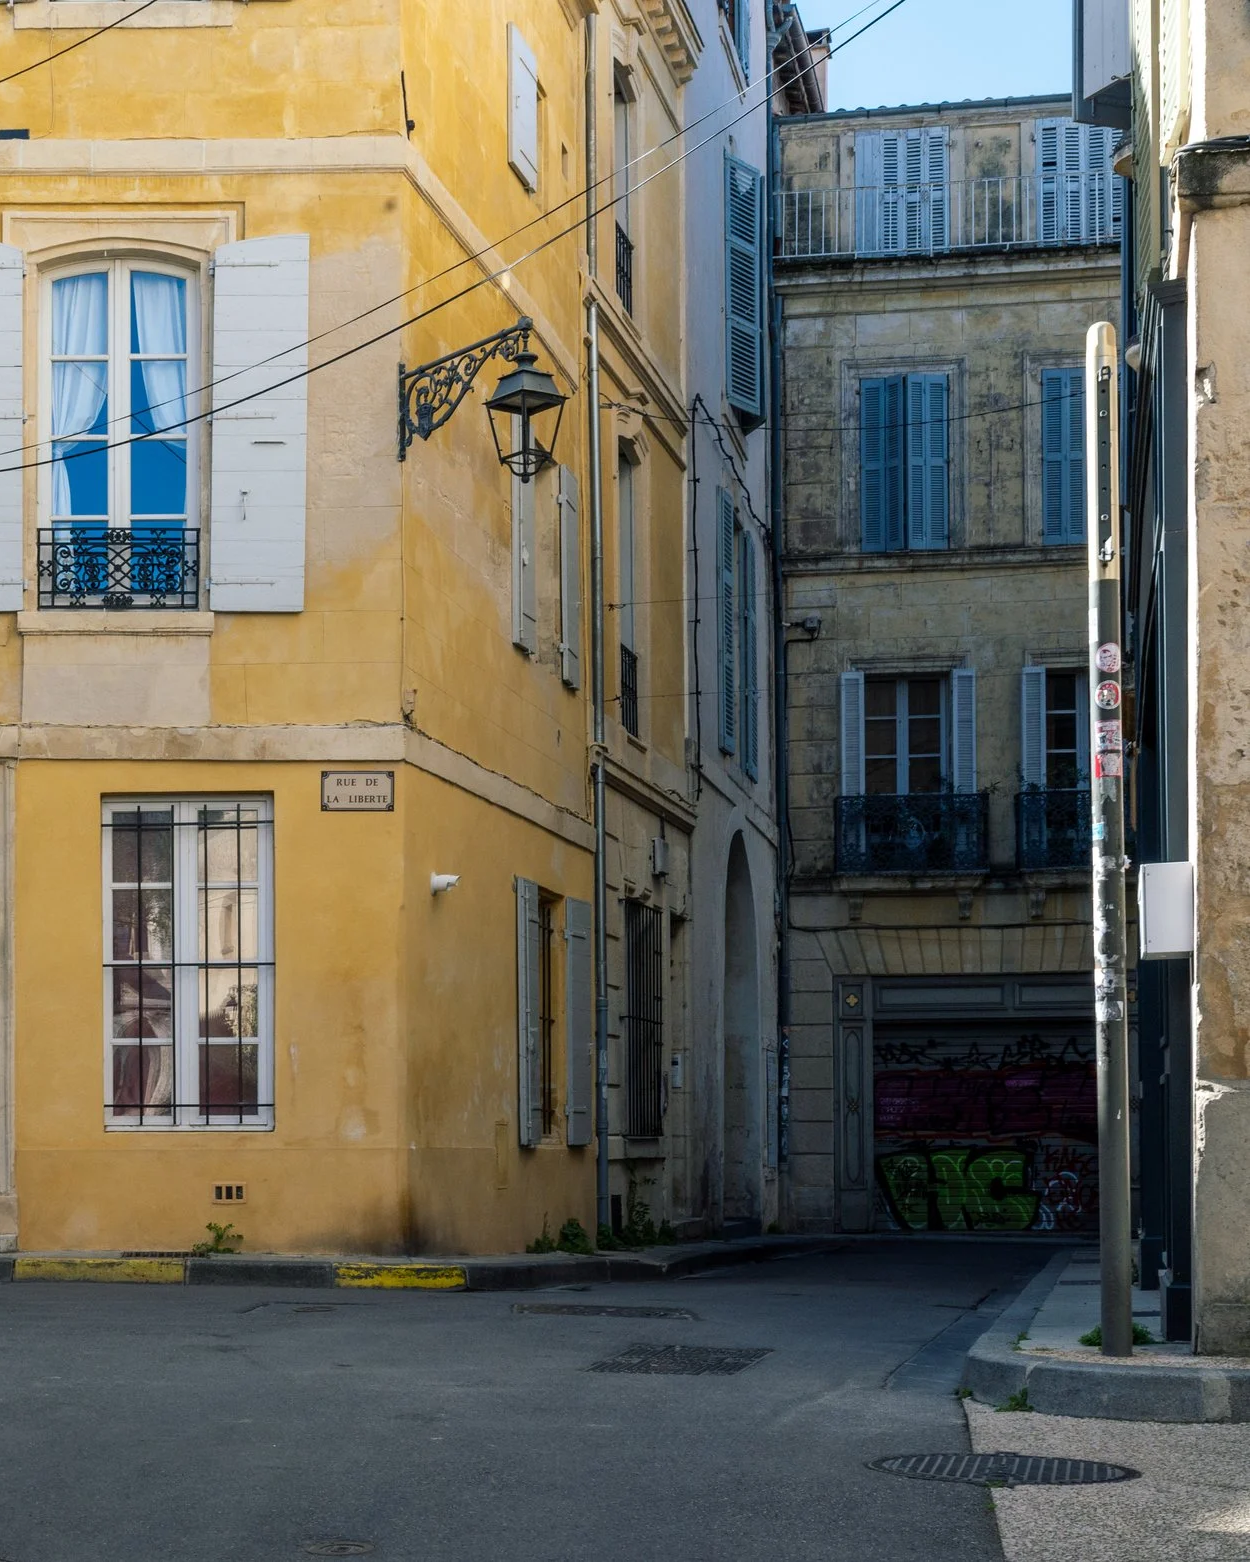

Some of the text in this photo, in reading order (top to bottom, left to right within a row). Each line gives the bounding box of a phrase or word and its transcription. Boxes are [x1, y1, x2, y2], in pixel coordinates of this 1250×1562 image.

[336, 778, 378, 787] RUE DE
[327, 795, 388, 803] LA LIBERTE
